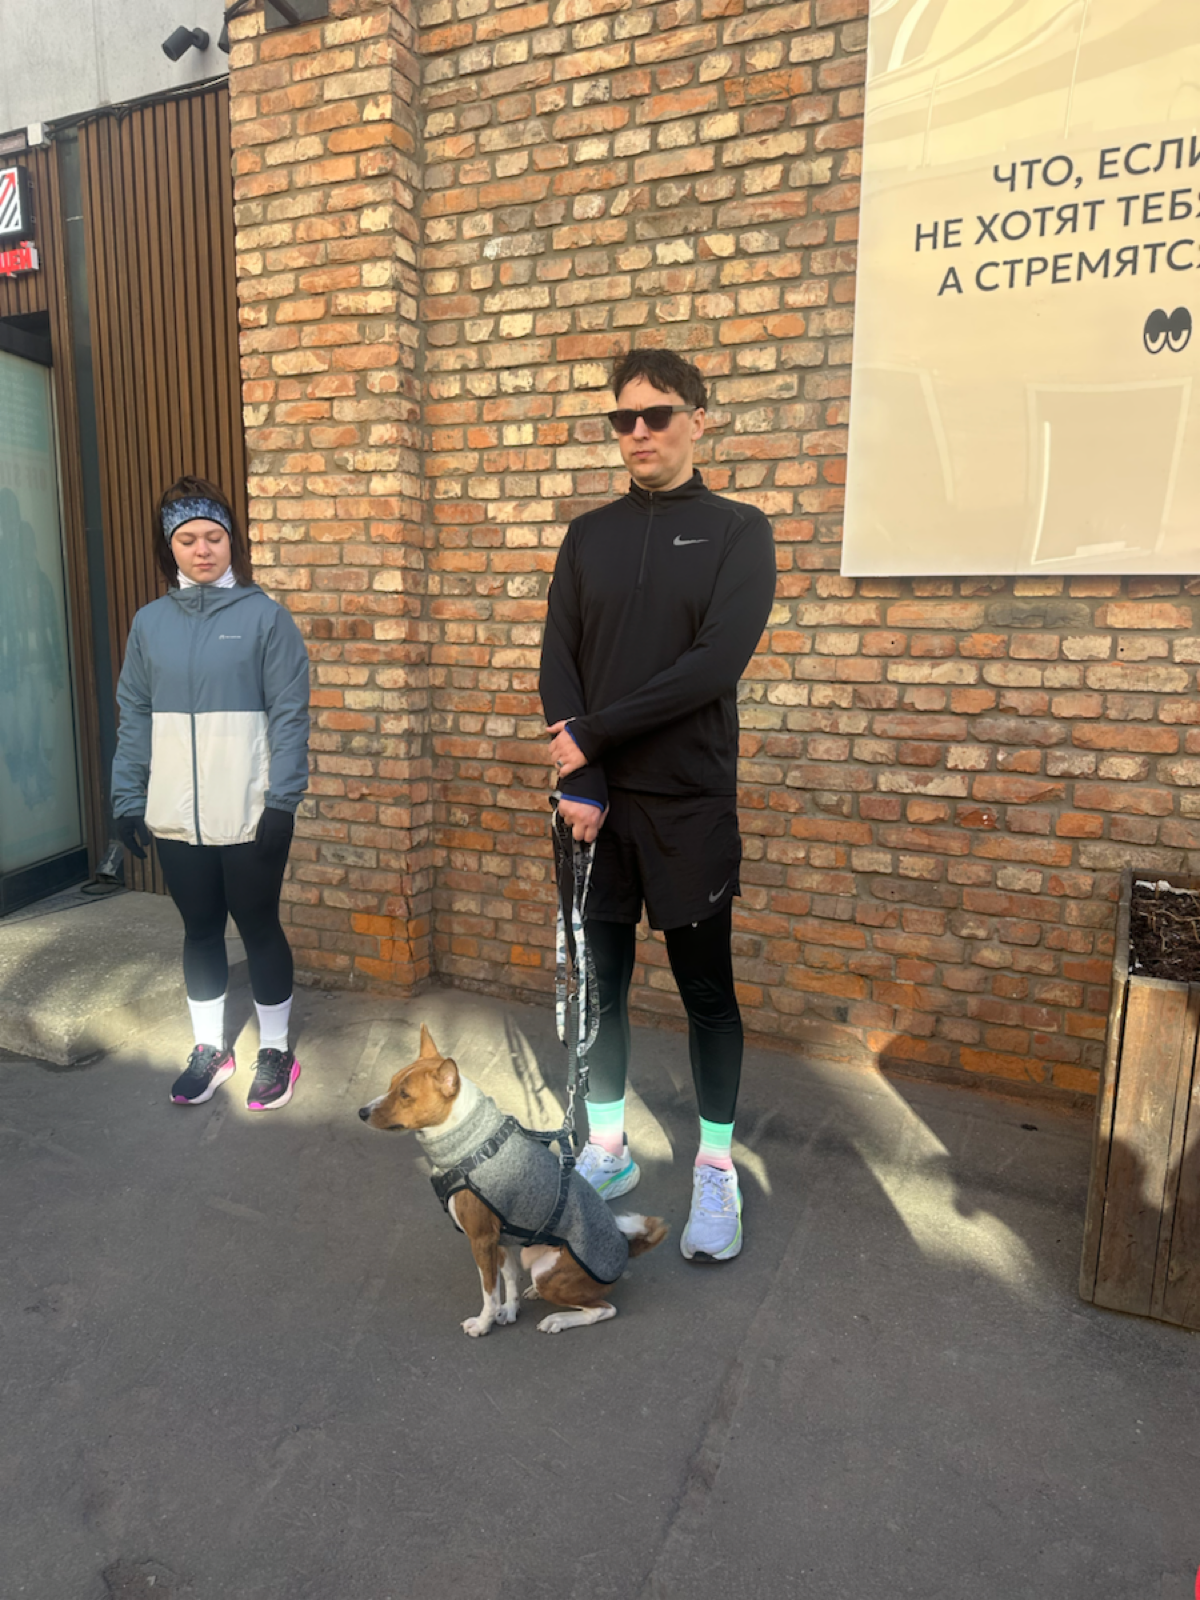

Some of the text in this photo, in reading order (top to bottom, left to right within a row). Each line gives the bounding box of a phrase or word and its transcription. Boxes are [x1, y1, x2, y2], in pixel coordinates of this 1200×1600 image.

[993, 155, 1083, 192] ЧТО,
[915, 188, 1200, 252] НЕ ХОТЯТ ТЕБ
[937, 239, 1200, 296] А СТРЕМЯТС
